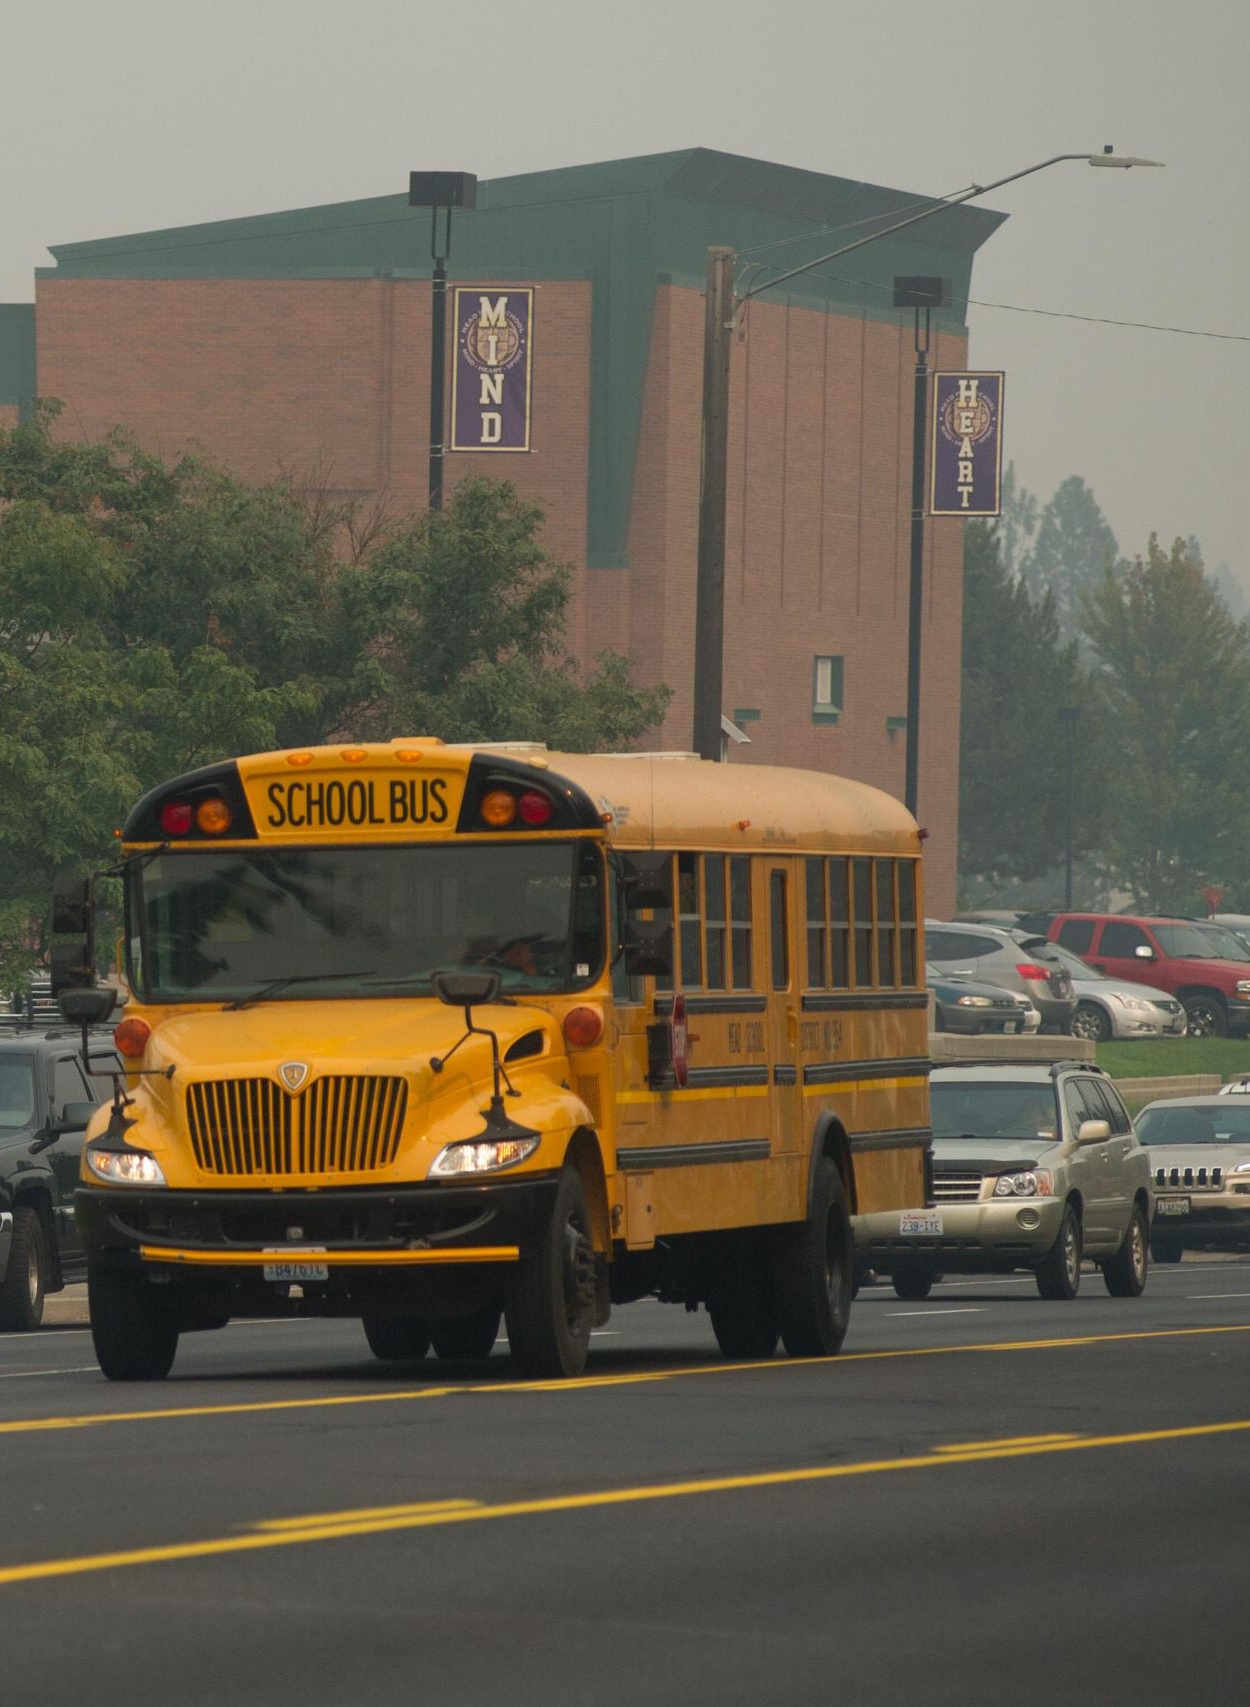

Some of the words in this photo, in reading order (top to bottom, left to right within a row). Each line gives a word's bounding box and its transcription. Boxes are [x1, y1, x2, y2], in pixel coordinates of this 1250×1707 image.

[507, 310, 524, 333] CHOOL
[479, 296, 508, 443] MIND
[957, 379, 979, 508] HEART
[267, 781, 385, 828] SCHOOL
[389, 778, 449, 825] BUS
